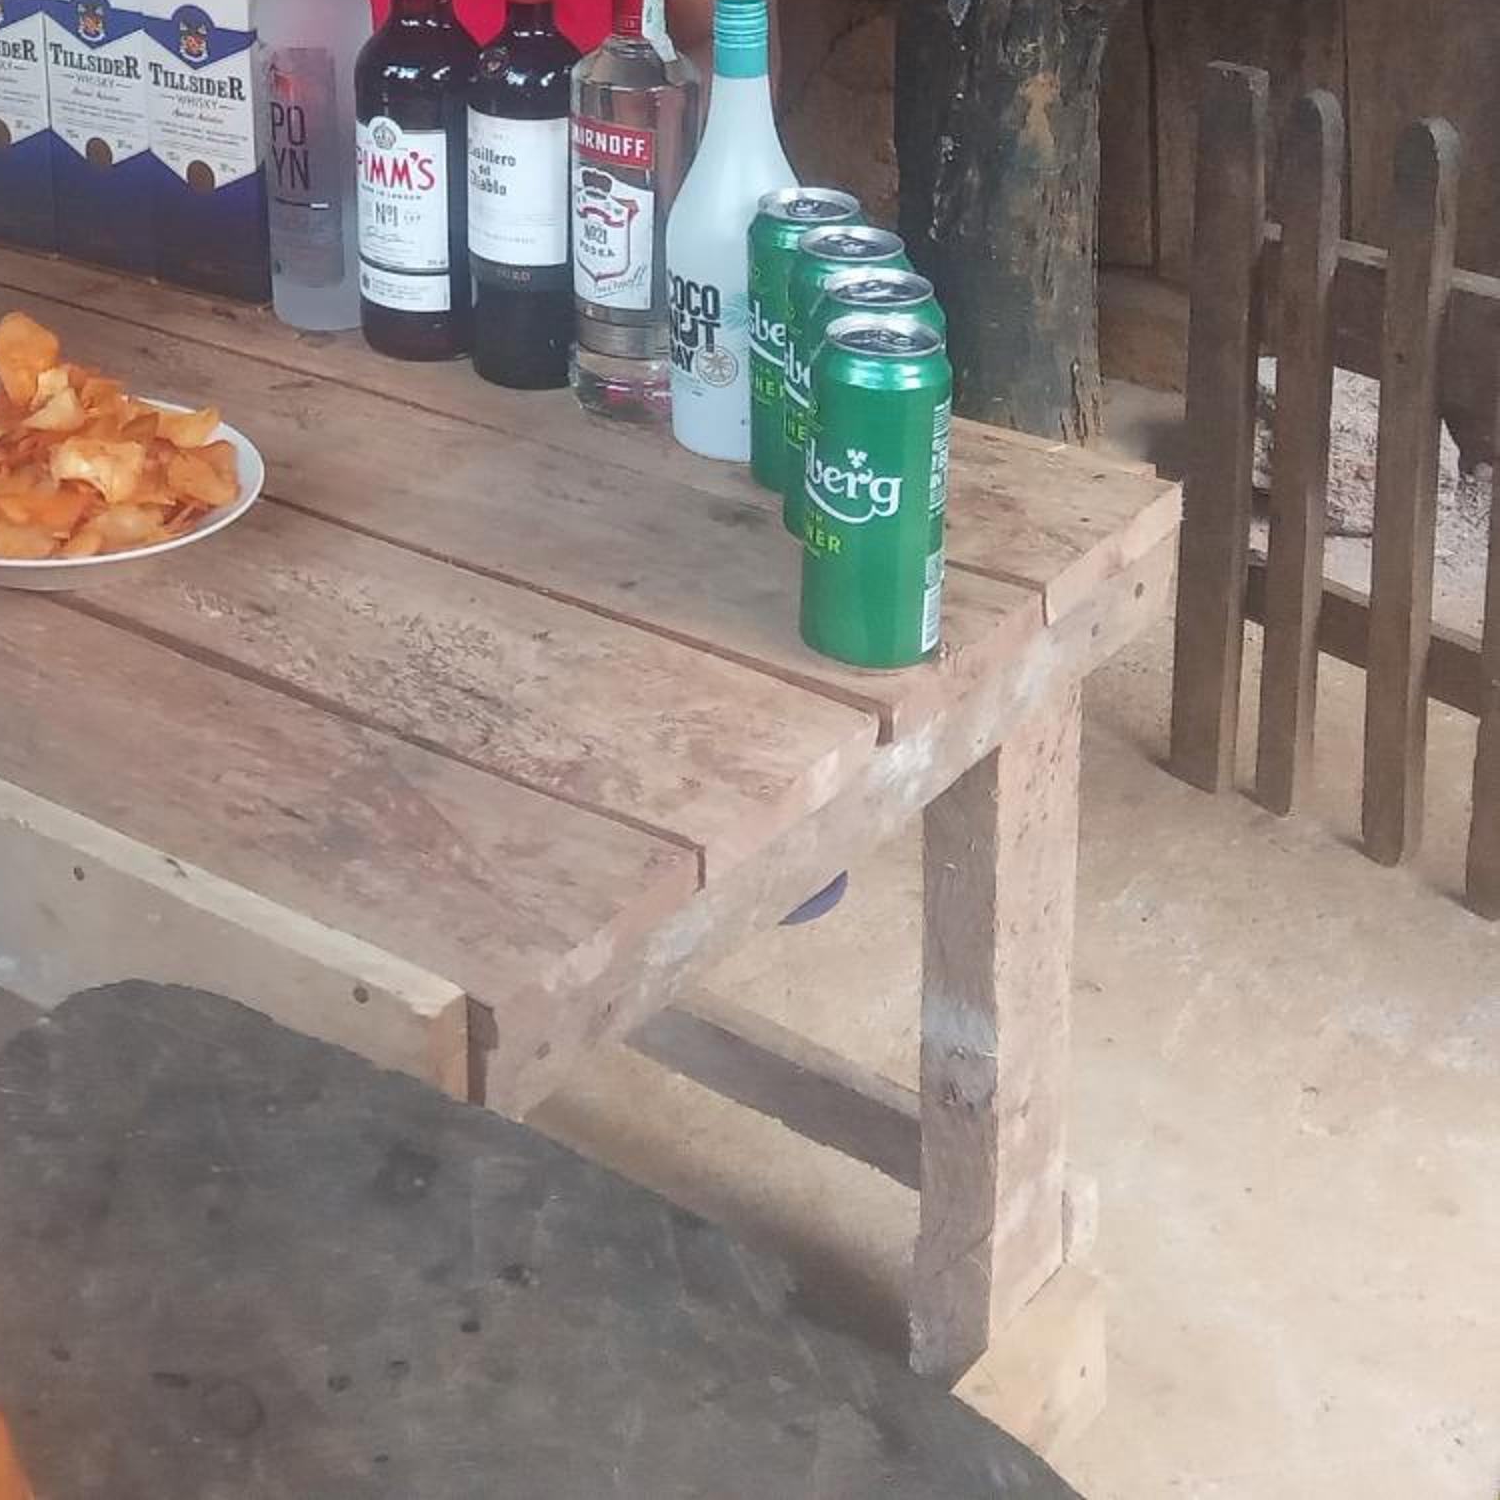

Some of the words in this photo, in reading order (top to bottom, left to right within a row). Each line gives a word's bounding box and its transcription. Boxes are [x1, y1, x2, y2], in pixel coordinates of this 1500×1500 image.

[49, 41, 142, 80] TILLSIDER
[148, 61, 246, 102] TILLSIDER
[270, 101, 307, 146] PO
[272, 145, 310, 190] YN
